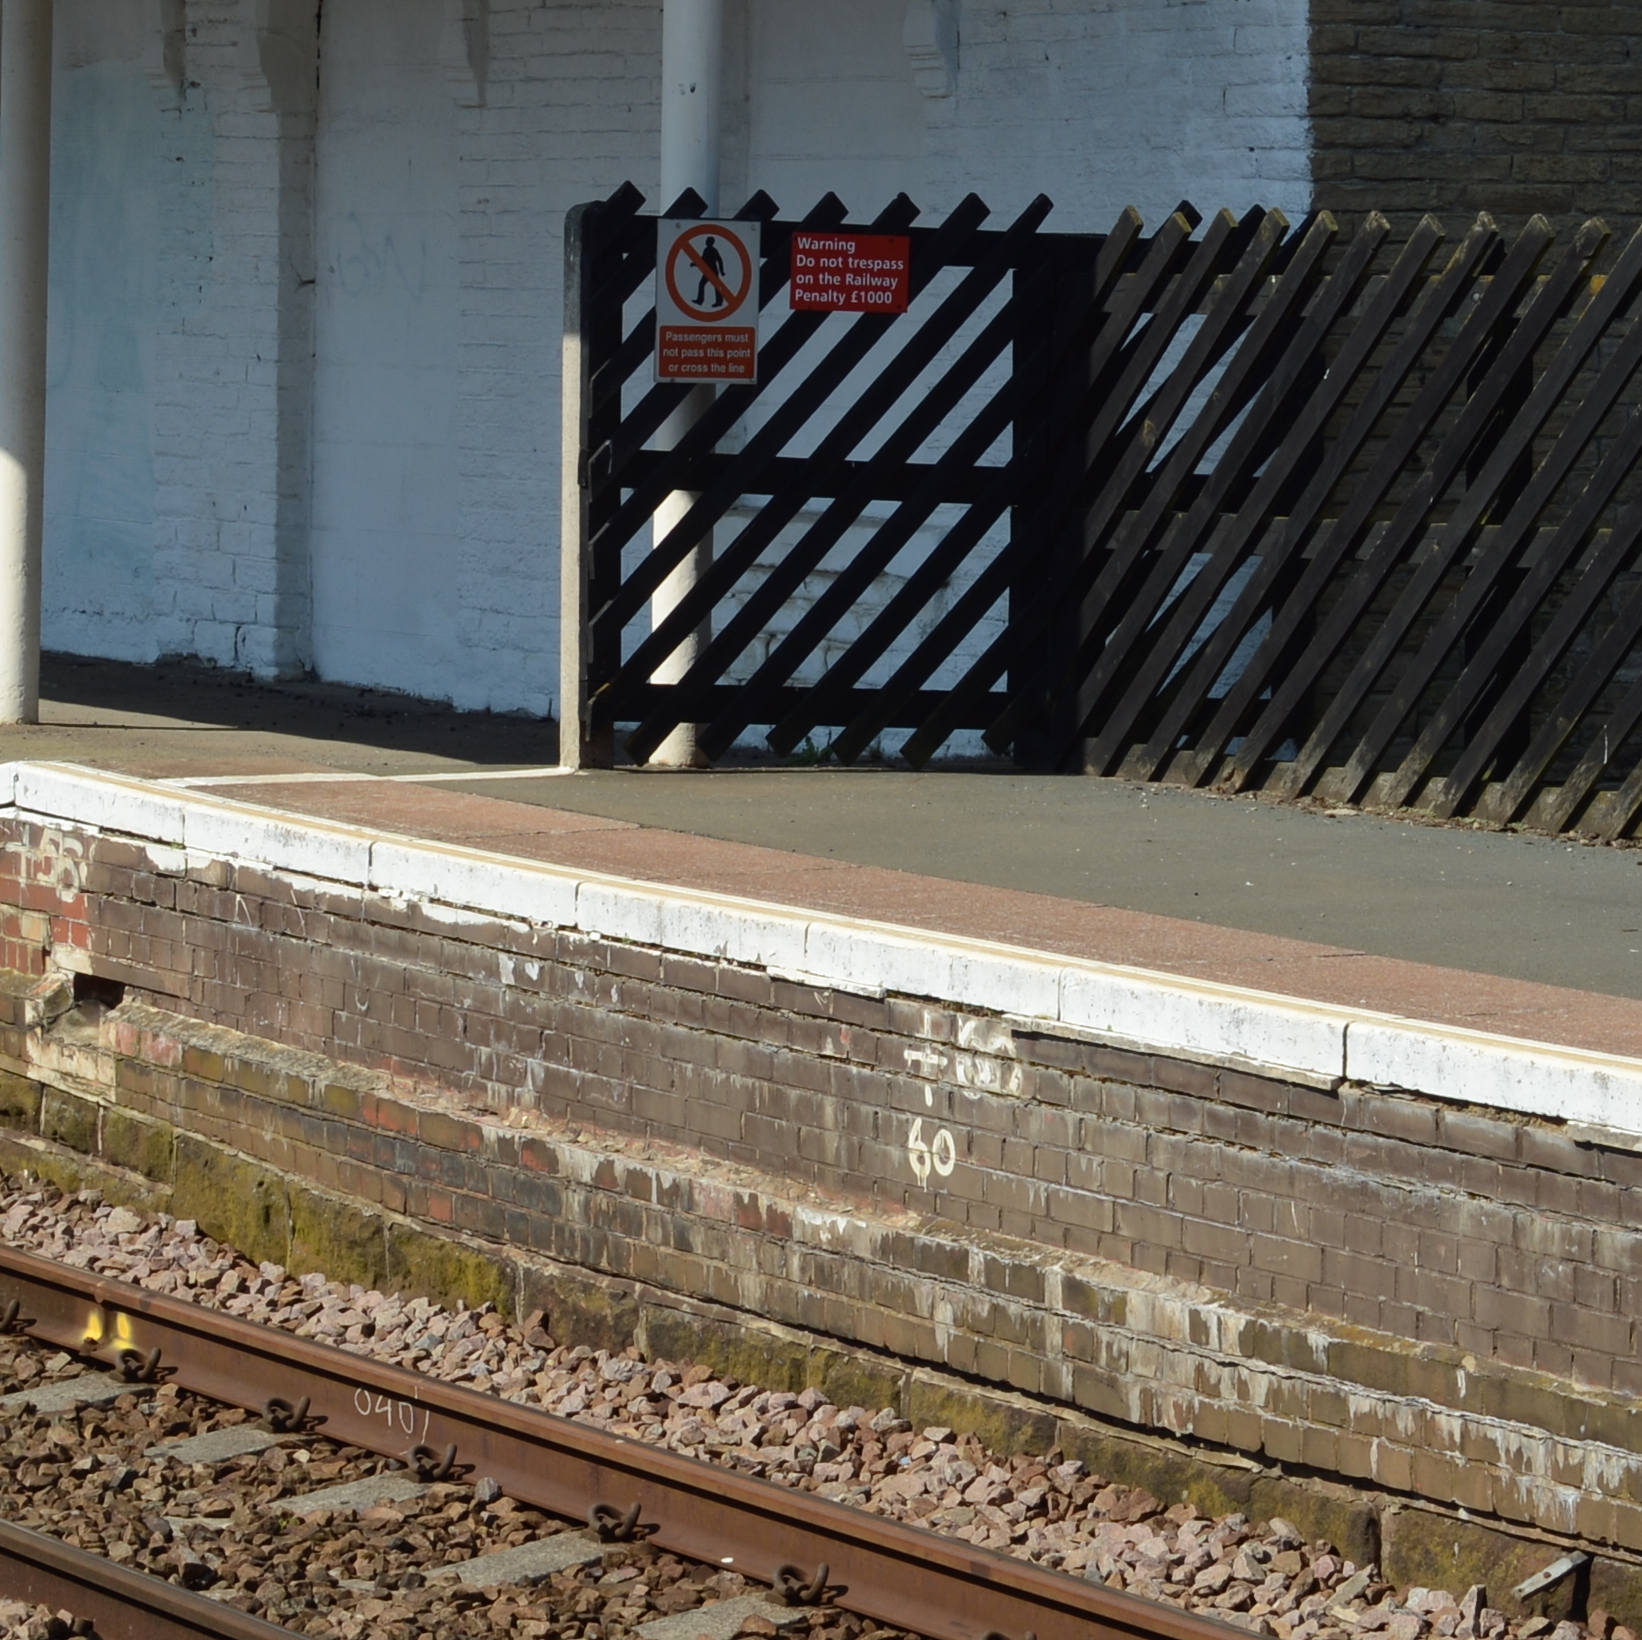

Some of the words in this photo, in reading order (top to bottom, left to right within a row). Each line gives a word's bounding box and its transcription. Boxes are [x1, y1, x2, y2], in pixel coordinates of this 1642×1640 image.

[797, 236, 856, 254] Warning
[796, 254, 815, 267] Do
[820, 256, 844, 268] not
[848, 256, 904, 272] trespass
[796, 274, 814, 284] on
[818, 272, 841, 285] the
[845, 273, 898, 290] Railway
[795, 289, 846, 306] Penalty
[850, 290, 893, 304] £1000
[665, 331, 723, 345] Passengers
[725, 333, 749, 343] must
[663, 348, 679, 357] not
[681, 349, 705, 359] pass
[707, 348, 724, 357] this
[726, 348, 751, 360] point
[668, 364, 679, 372] or
[681, 364, 708, 372] cross
[711, 363, 726, 373] the
[728, 363, 745, 373] line
[908, 1117, 956, 1184] 60
